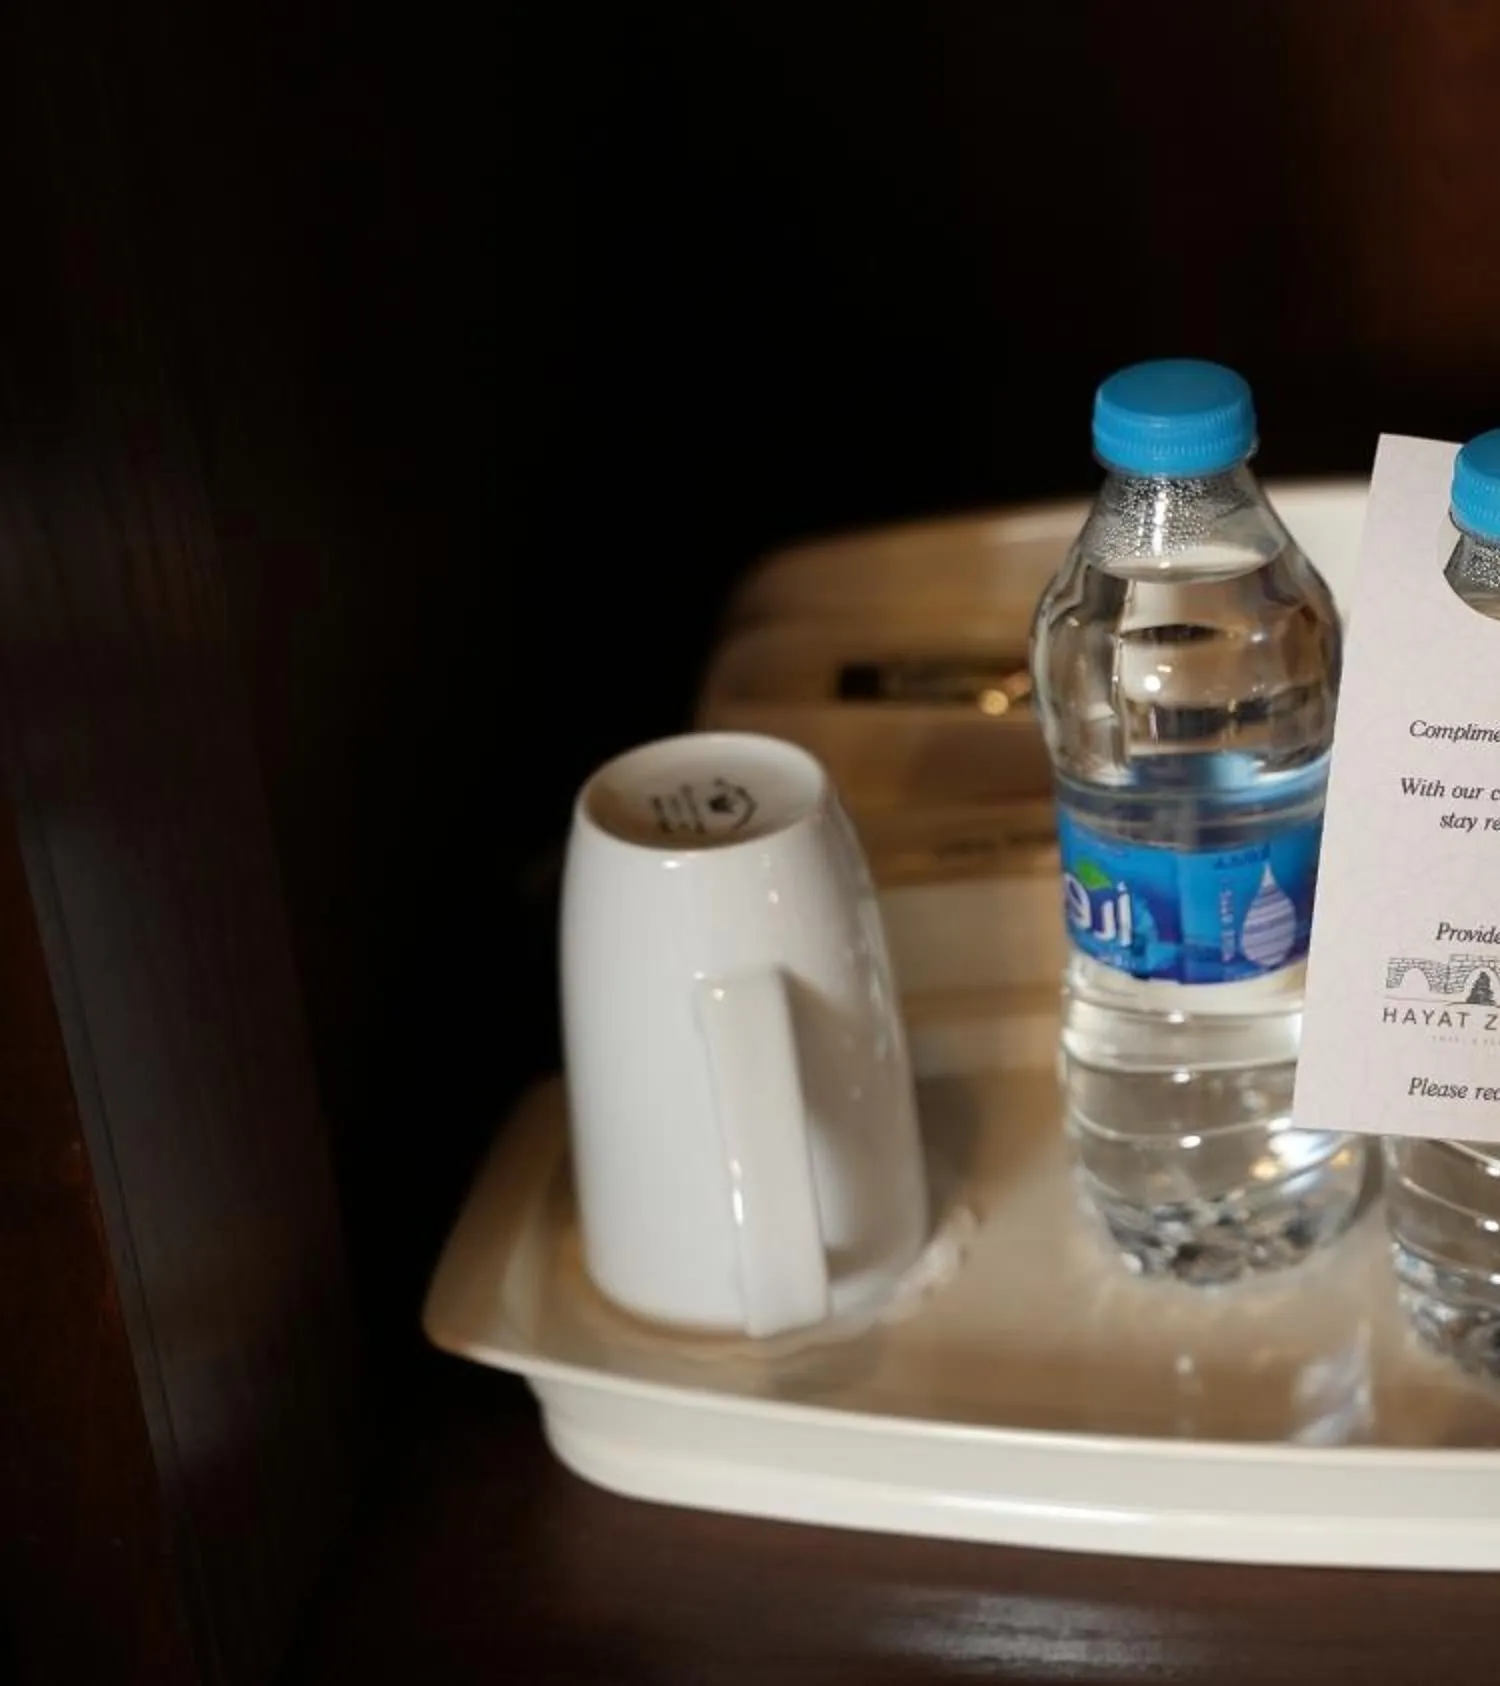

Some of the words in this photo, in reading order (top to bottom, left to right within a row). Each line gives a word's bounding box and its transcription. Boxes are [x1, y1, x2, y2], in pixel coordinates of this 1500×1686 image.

[1400, 777, 1445, 798] With
[1451, 785, 1484, 800] our
[1440, 813, 1478, 832] stay
[1382, 1007, 1471, 1029] HAYAT
[1408, 1077, 1467, 1099] Please
